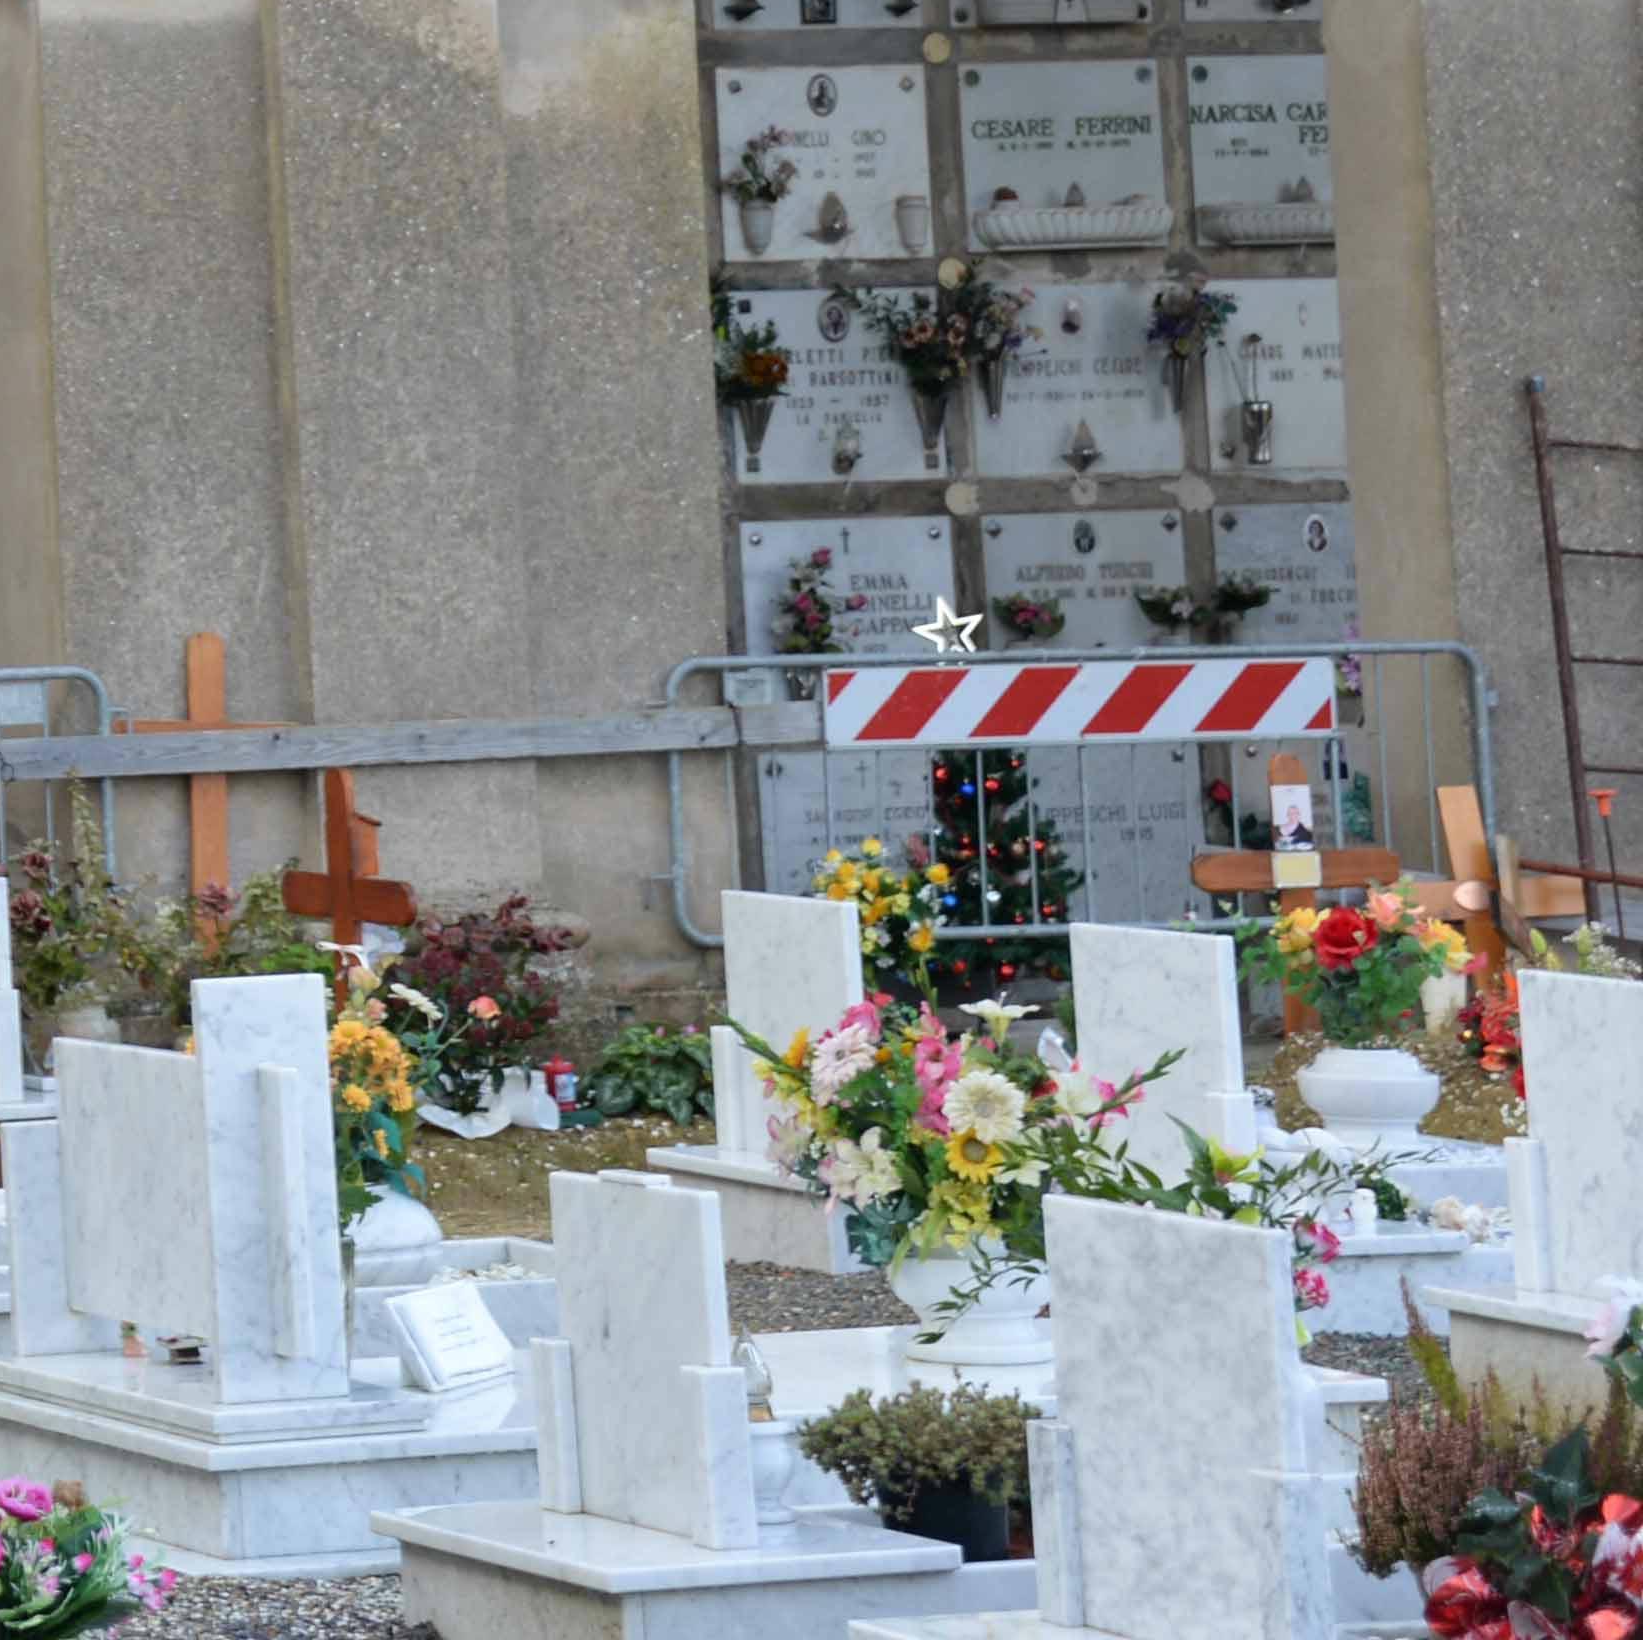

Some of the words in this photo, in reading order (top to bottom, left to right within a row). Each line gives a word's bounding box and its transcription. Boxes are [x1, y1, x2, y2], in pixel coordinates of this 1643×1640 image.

[1188, 103, 1277, 125] NARCISA
[971, 118, 1053, 140] CESARE
[1075, 114, 1153, 136] FERRINI
